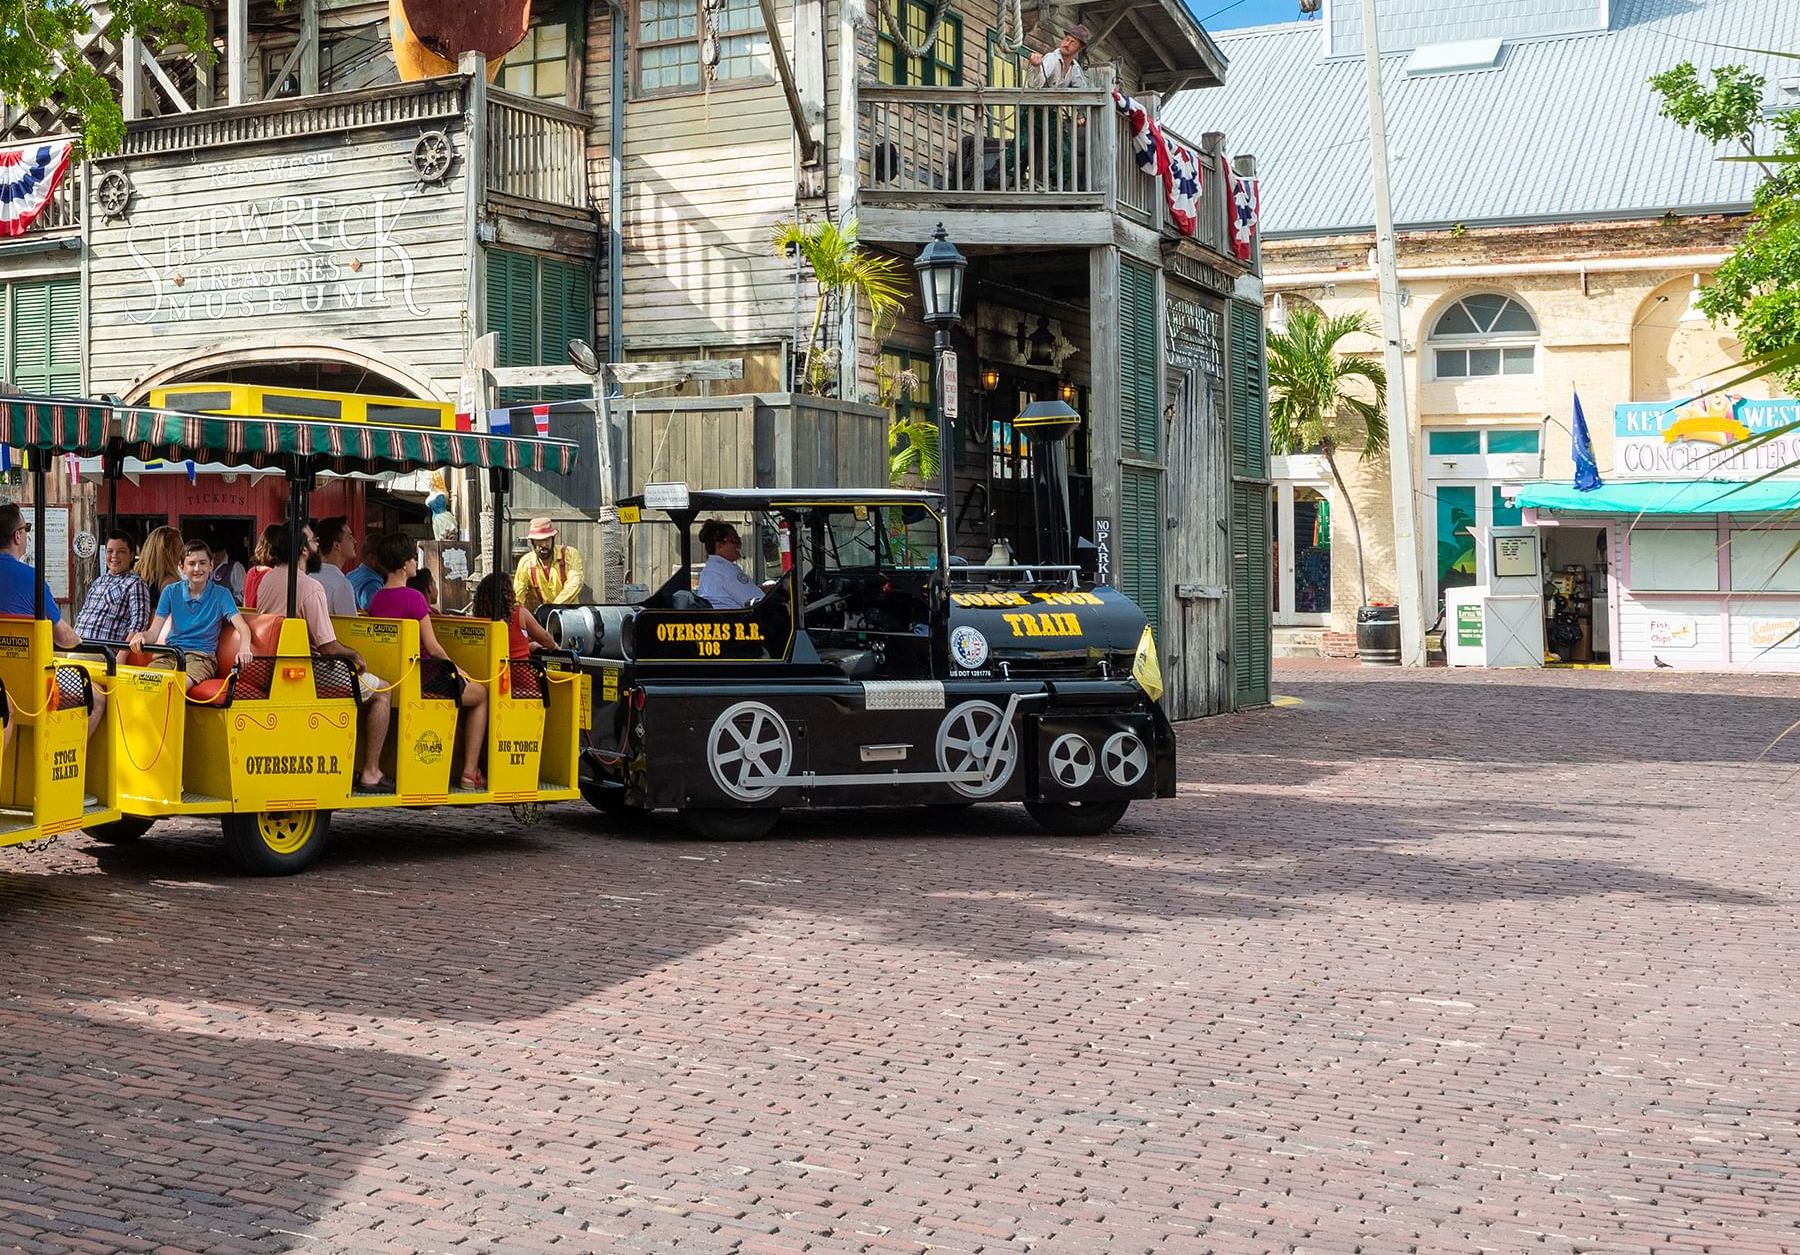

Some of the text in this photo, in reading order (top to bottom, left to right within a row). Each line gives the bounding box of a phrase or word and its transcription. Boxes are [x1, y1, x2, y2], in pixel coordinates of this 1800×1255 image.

[206, 153, 335, 189] KEY WEST
[125, 190, 430, 324] SHIPWRECK
[192, 253, 342, 292] TREASURES
[167, 281, 366, 322] MUSEUM
[1627, 410, 1665, 431] KEY
[1624, 443, 1699, 472] CONCH
[187, 494, 245, 506] TICKETS
[1096, 520, 1110, 530] NO
[951, 592, 1105, 607] CONCH TOUR
[374, 624, 398, 633] CAUTION
[461, 627, 486, 635] CAUTION
[657, 622, 765, 641] OVERSEAS R.R.
[1001, 612, 1083, 637] TRAIN
[1650, 621, 1670, 631] Fish
[1651, 634, 1672, 644] Chips
[698, 641, 721, 656] 108
[139, 672, 163, 681] CAUTION
[498, 740, 539, 753] BIG TORCH
[54, 749, 77, 765] STOCK
[510, 753, 526, 765] KEY
[246, 755, 342, 775] OVERSEAS R.R.
[52, 765, 79, 781] ISLAND
